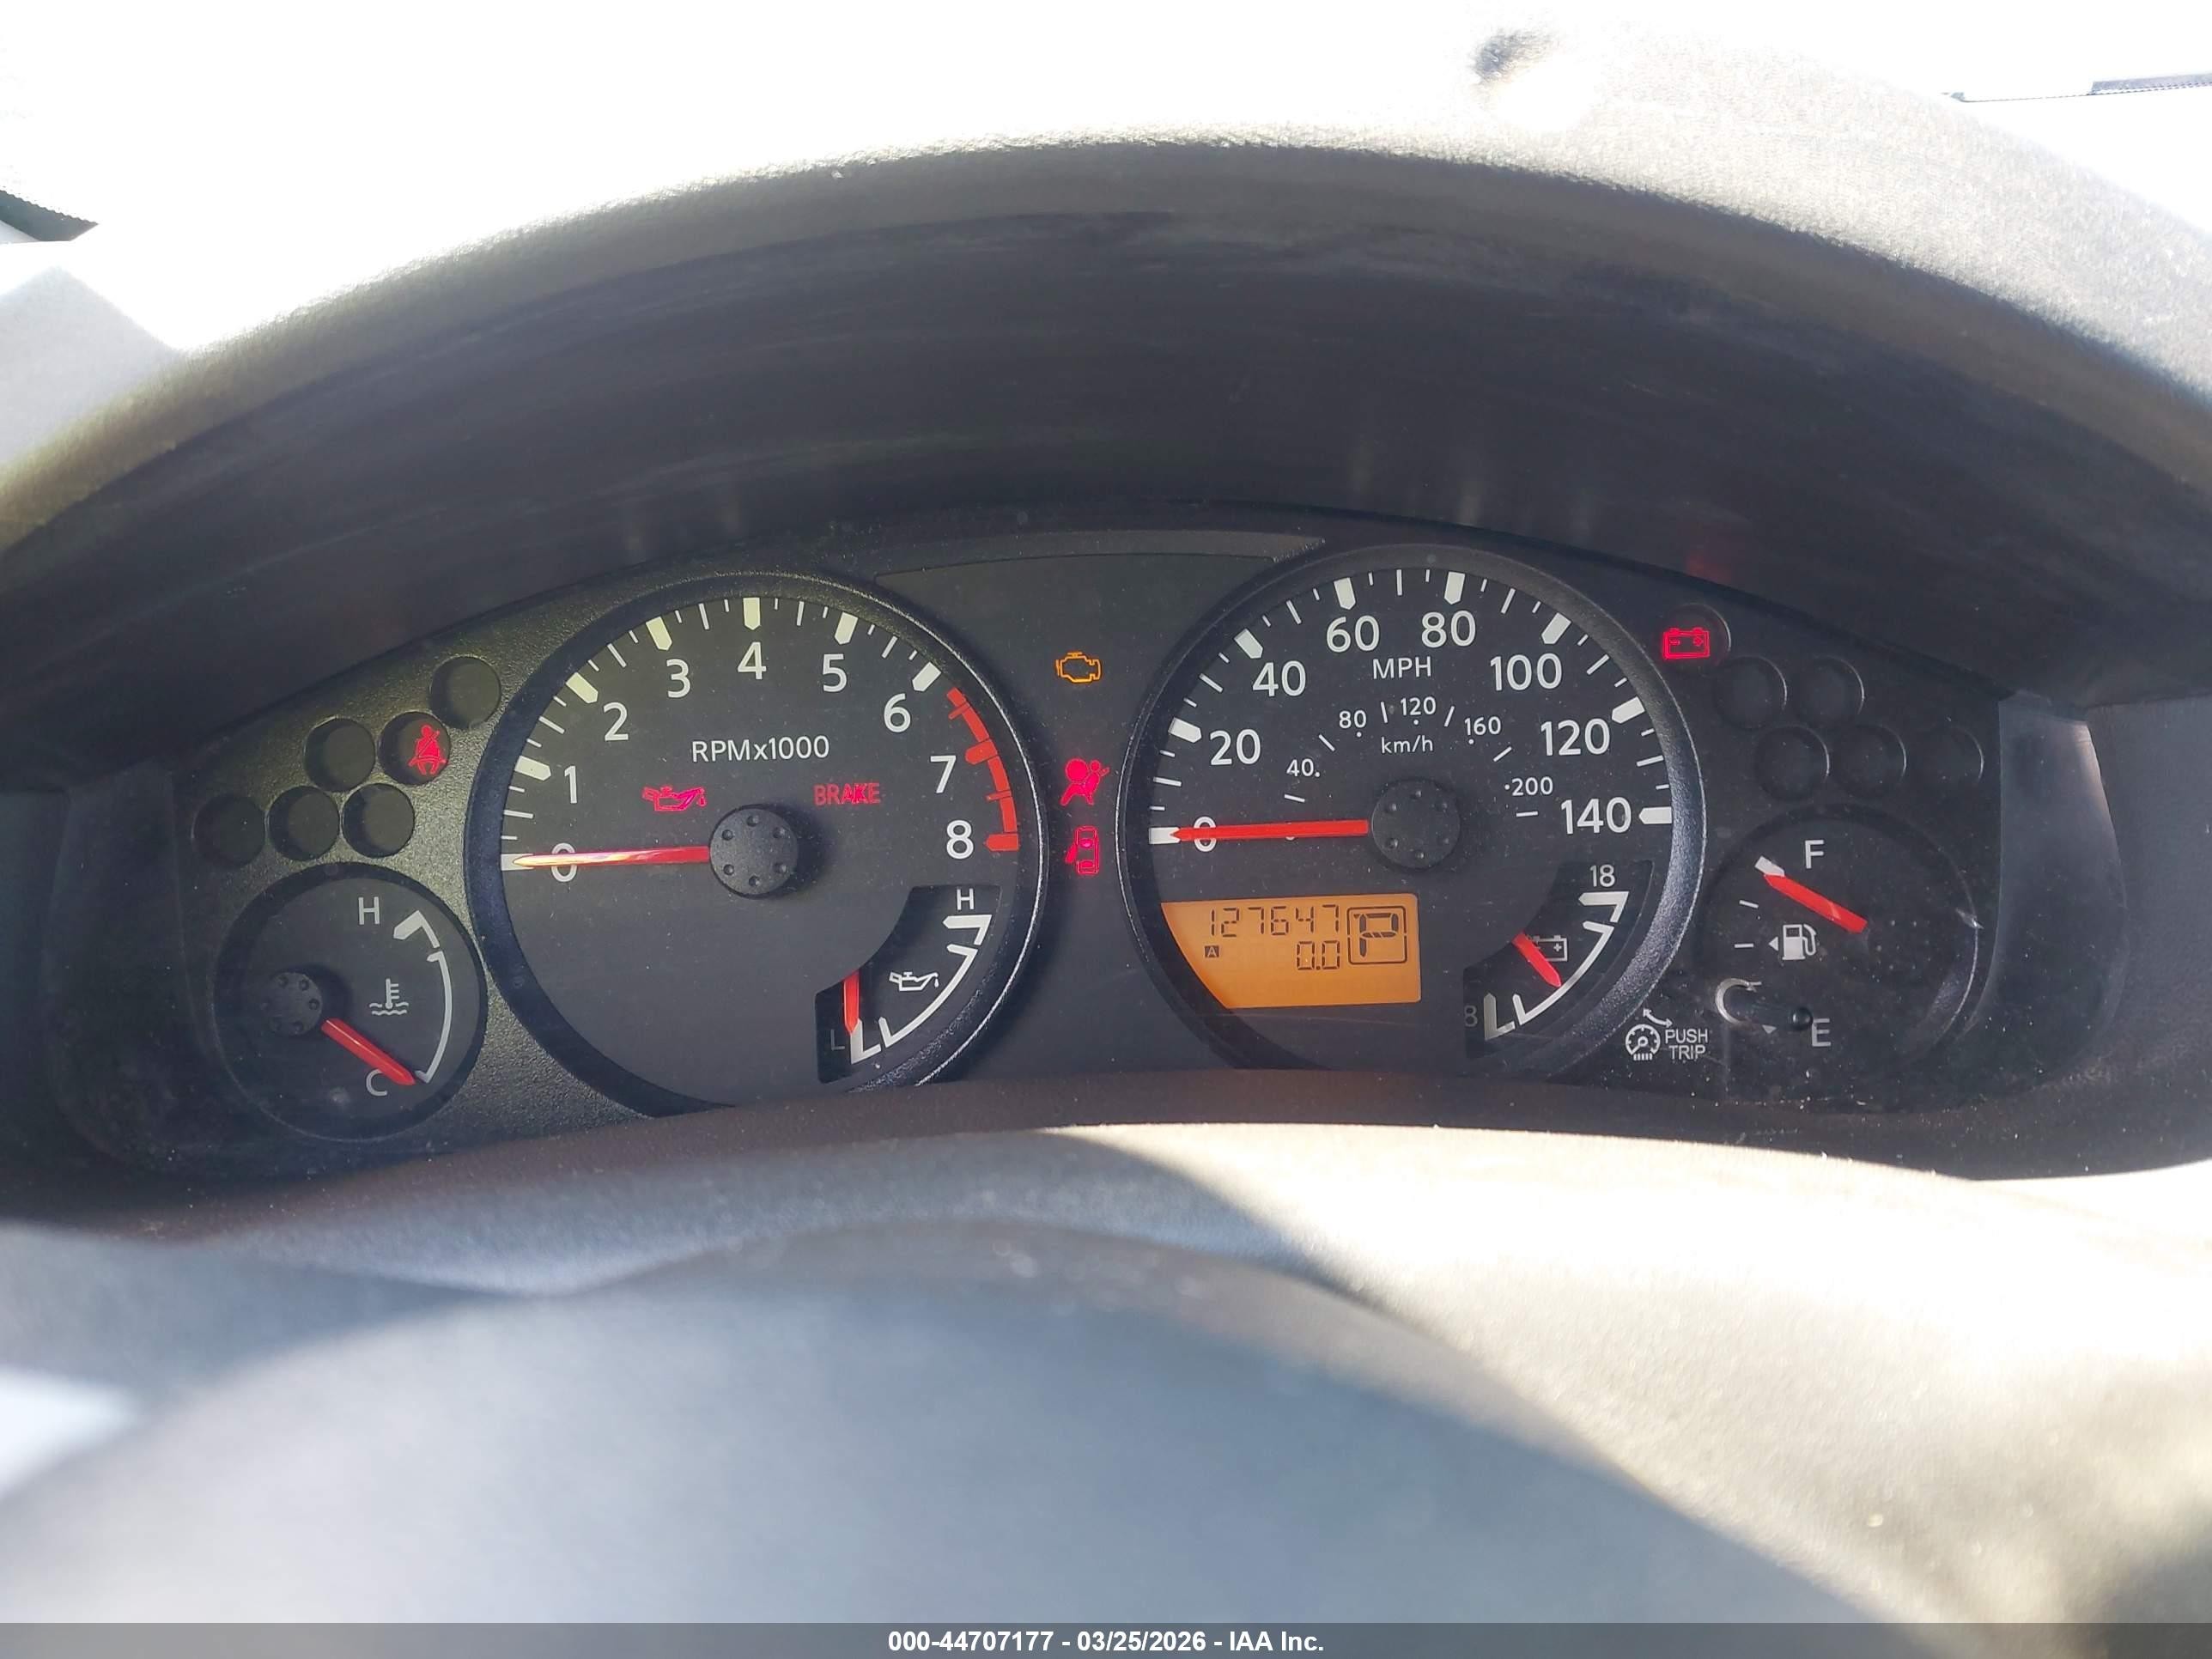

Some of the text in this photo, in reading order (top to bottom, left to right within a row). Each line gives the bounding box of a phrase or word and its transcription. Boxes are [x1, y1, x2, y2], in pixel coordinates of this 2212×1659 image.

[1326, 615, 1380, 653] 60
[1421, 610, 1476, 648] 80
[737, 641, 767, 680] 4
[822, 653, 848, 692] 5
[1372, 656, 1431, 679] MPH
[1490, 653, 1562, 691] 100
[666, 658, 691, 698] 3
[1252, 660, 1306, 697] 40
[884, 693, 911, 732] 6
[1339, 709, 1367, 729] 80
[1400, 696, 1437, 716] 120
[603, 702, 629, 742] 2
[1464, 716, 1501, 736] 160
[692, 735, 830, 763] RPMx1000
[1210, 728, 1261, 766] 20
[1381, 734, 1433, 754] km/h
[1540, 718, 1610, 757] 120
[930, 755, 957, 793] 7
[1286, 758, 1314, 777] 40
[564, 765, 578, 804] 1
[814, 782, 881, 805] BRAKE
[1511, 776, 1553, 796] 200
[1560, 796, 1632, 835] 140
[946, 819, 974, 860] 8
[1804, 839, 1825, 869] F
[1590, 864, 1615, 888] 18
[358, 896, 380, 926] H
[957, 888, 975, 910] H
[1210, 904, 1340, 938] 127647
[1353, 912, 1399, 957] P
[1297, 940, 1340, 970] 0.0
[1664, 1028, 1708, 1044] PUSH
[1812, 1018, 1832, 1047] E
[1668, 1044, 1706, 1060] TRIP
[366, 1068, 388, 1097] C
